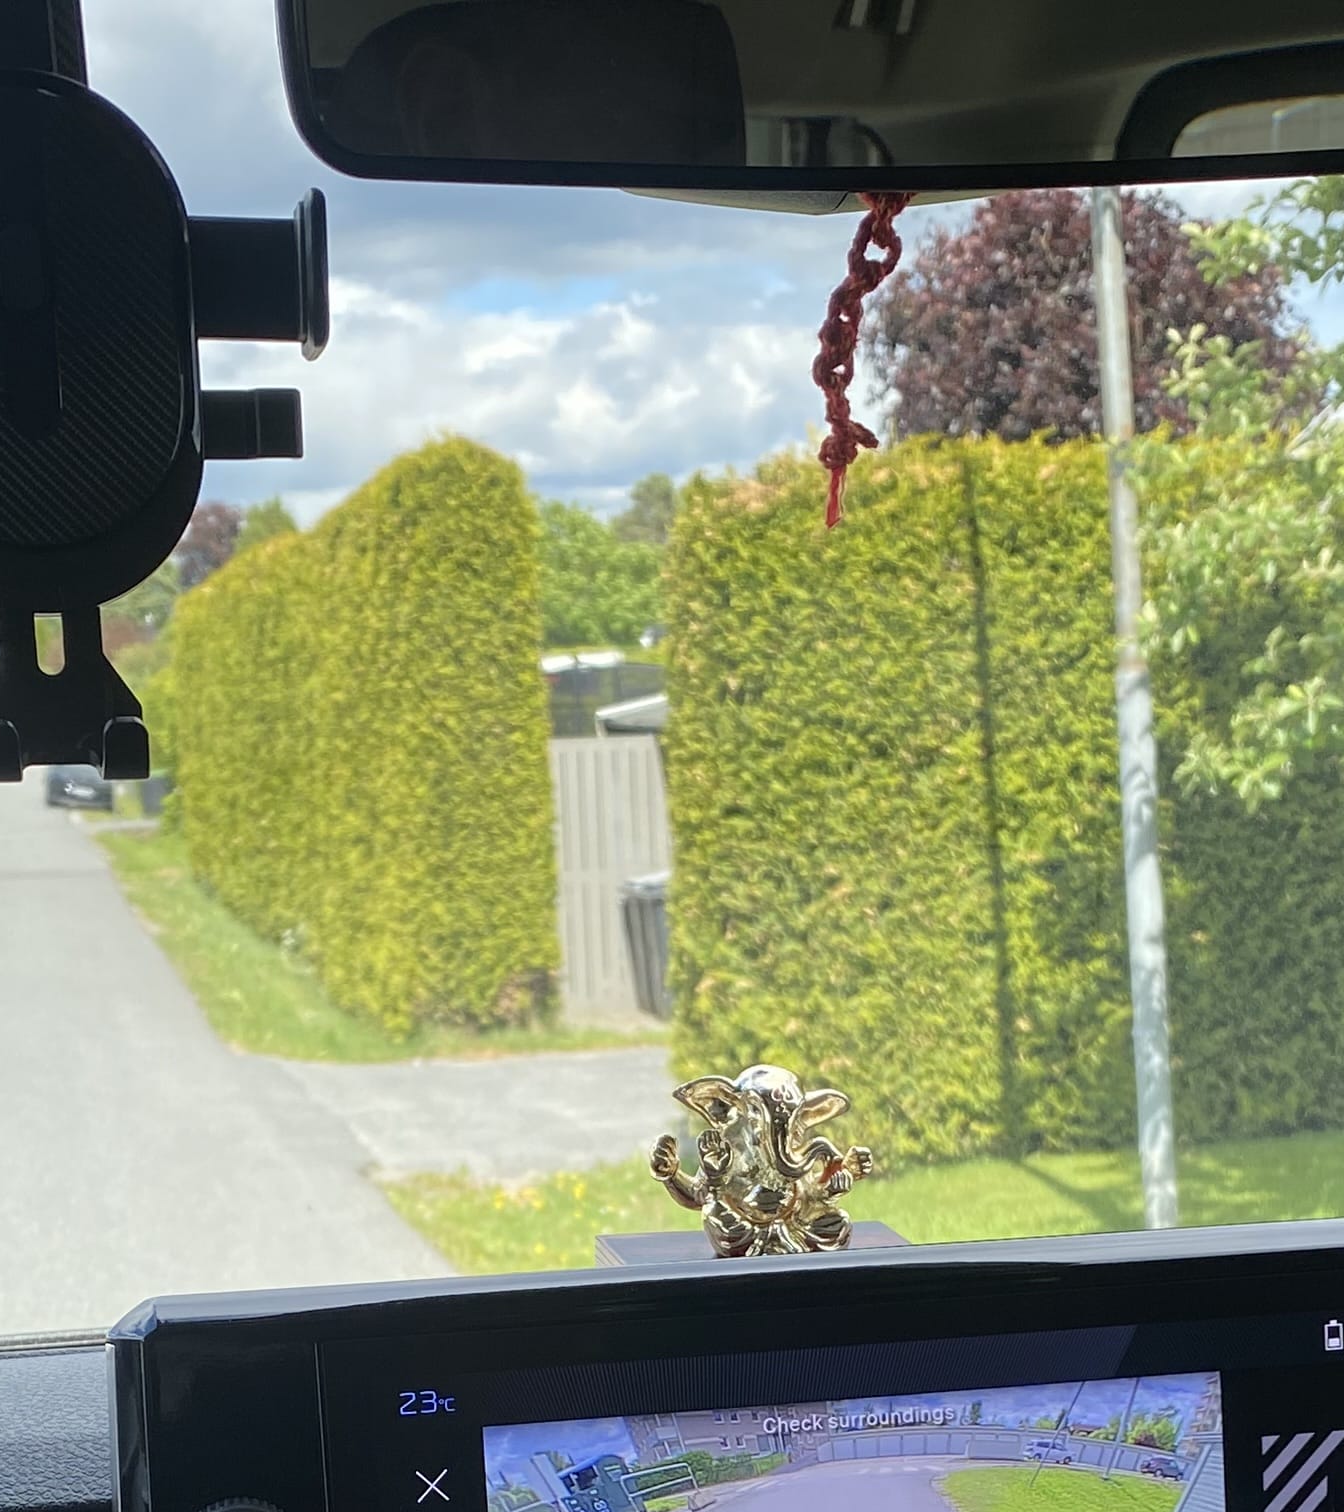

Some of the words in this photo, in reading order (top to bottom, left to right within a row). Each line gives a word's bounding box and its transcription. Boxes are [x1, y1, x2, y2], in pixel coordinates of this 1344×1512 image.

[399, 1391, 456, 1415] 23°C
[763, 1413, 824, 1434] Check
[828, 1406, 955, 1429] surroundings
